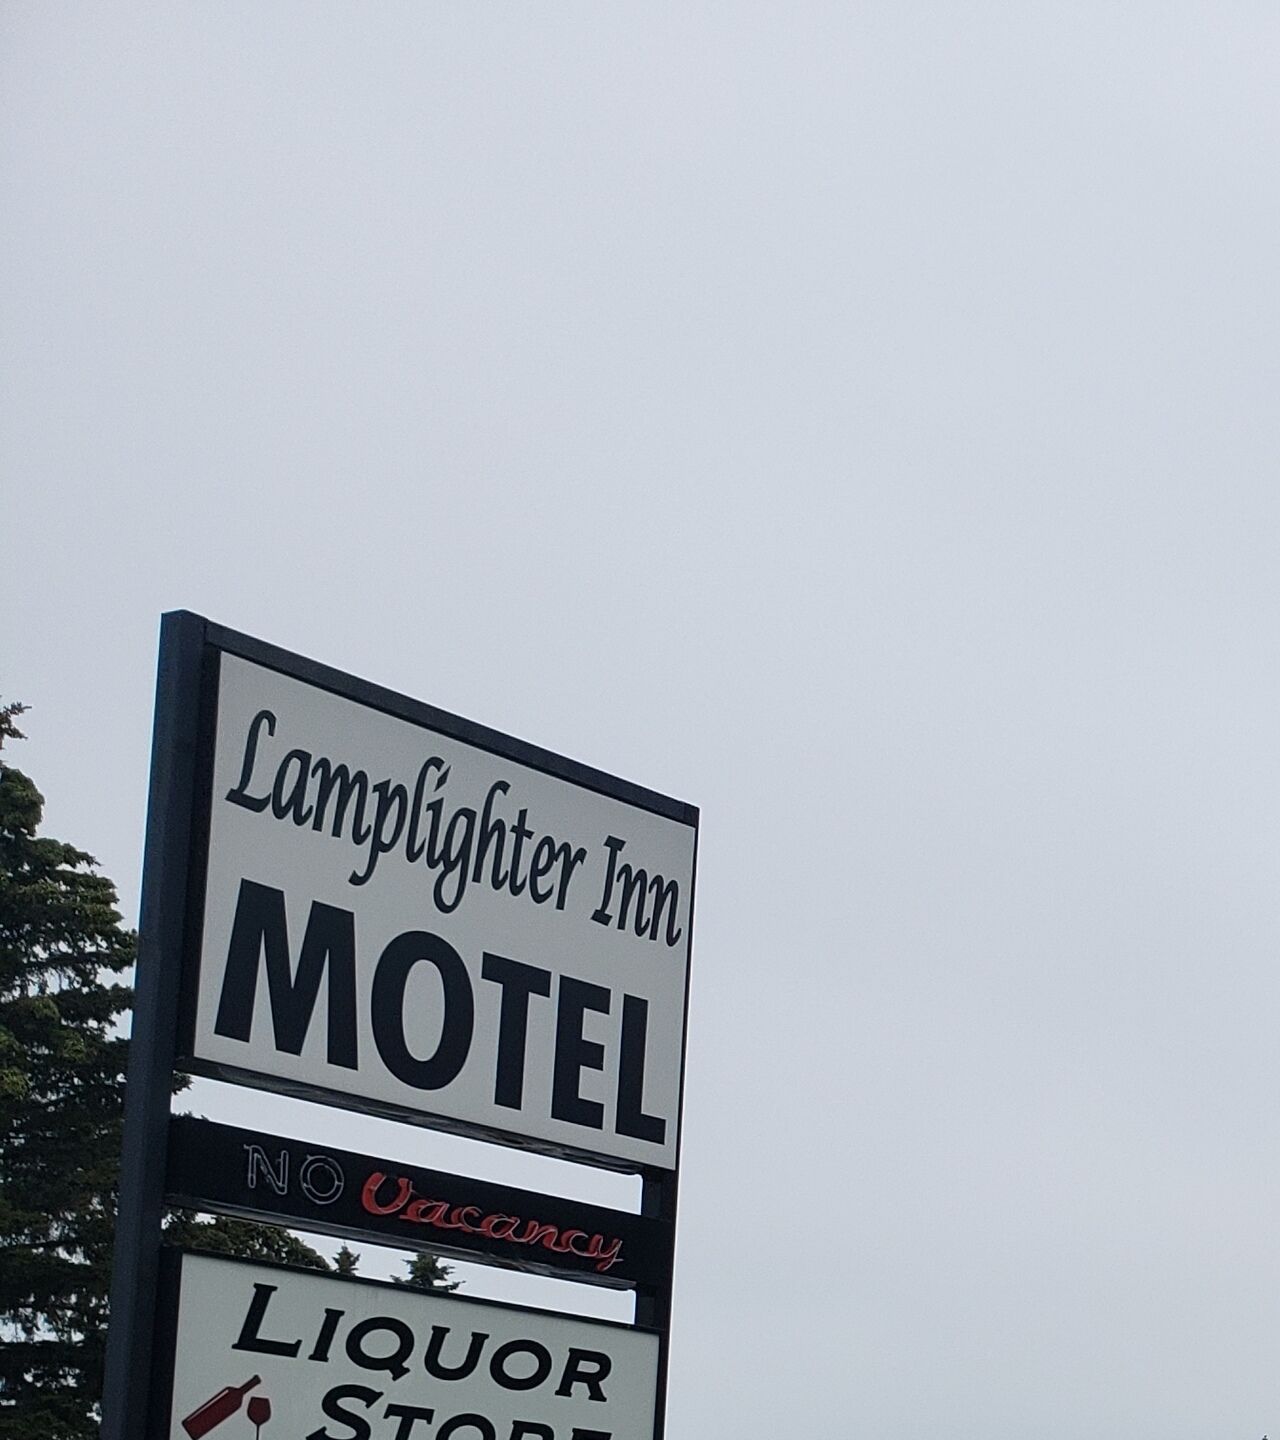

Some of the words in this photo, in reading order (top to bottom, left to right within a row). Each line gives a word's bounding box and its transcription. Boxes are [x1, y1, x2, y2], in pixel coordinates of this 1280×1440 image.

[224, 709, 587, 914] Lamplighter
[590, 834, 682, 948] Inn
[213, 877, 668, 1146] MOTEL
[242, 1142, 345, 1205] NO
[361, 1171, 625, 1272] Vacancy
[231, 1282, 613, 1403] LIQUOR
